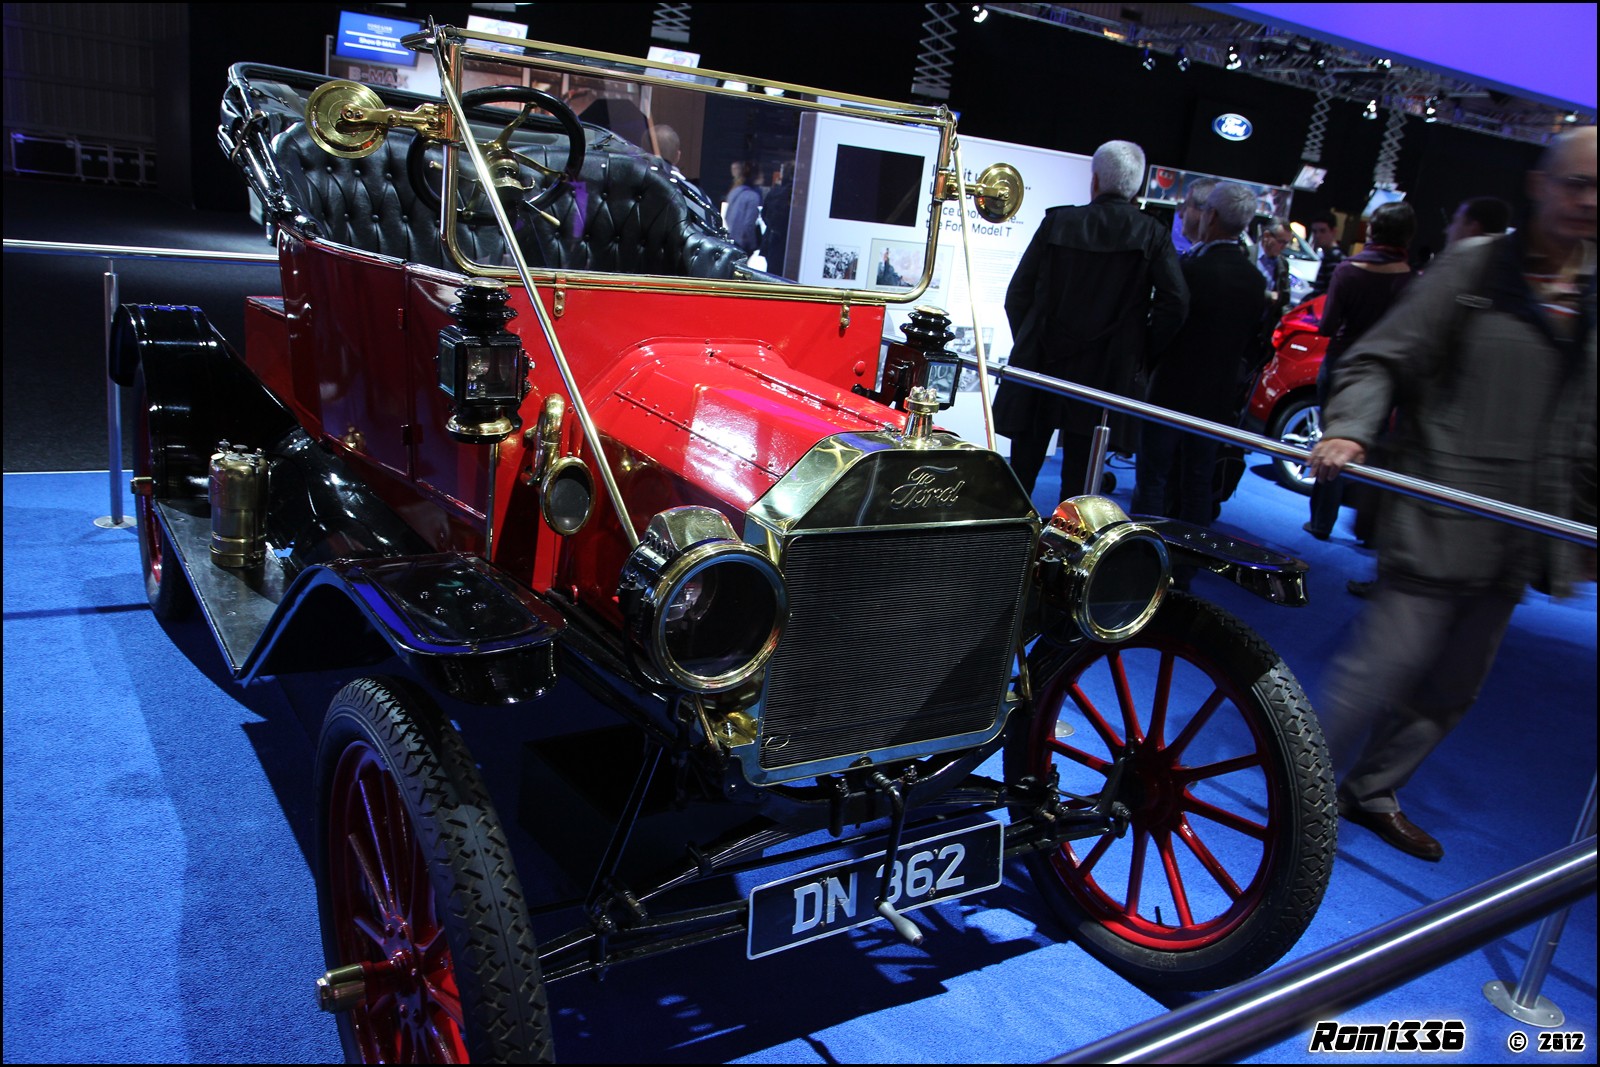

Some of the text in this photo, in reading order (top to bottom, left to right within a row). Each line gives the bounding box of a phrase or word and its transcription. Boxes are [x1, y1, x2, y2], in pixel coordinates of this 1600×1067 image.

[348, 65, 409, 89] B-MAX
[1221, 116, 1247, 137] Ford
[945, 219, 964, 232] For
[971, 222, 1003, 237] Model
[1005, 226, 1013, 237] T
[890, 464, 967, 510] Ford
[791, 843, 966, 935] DN 362
